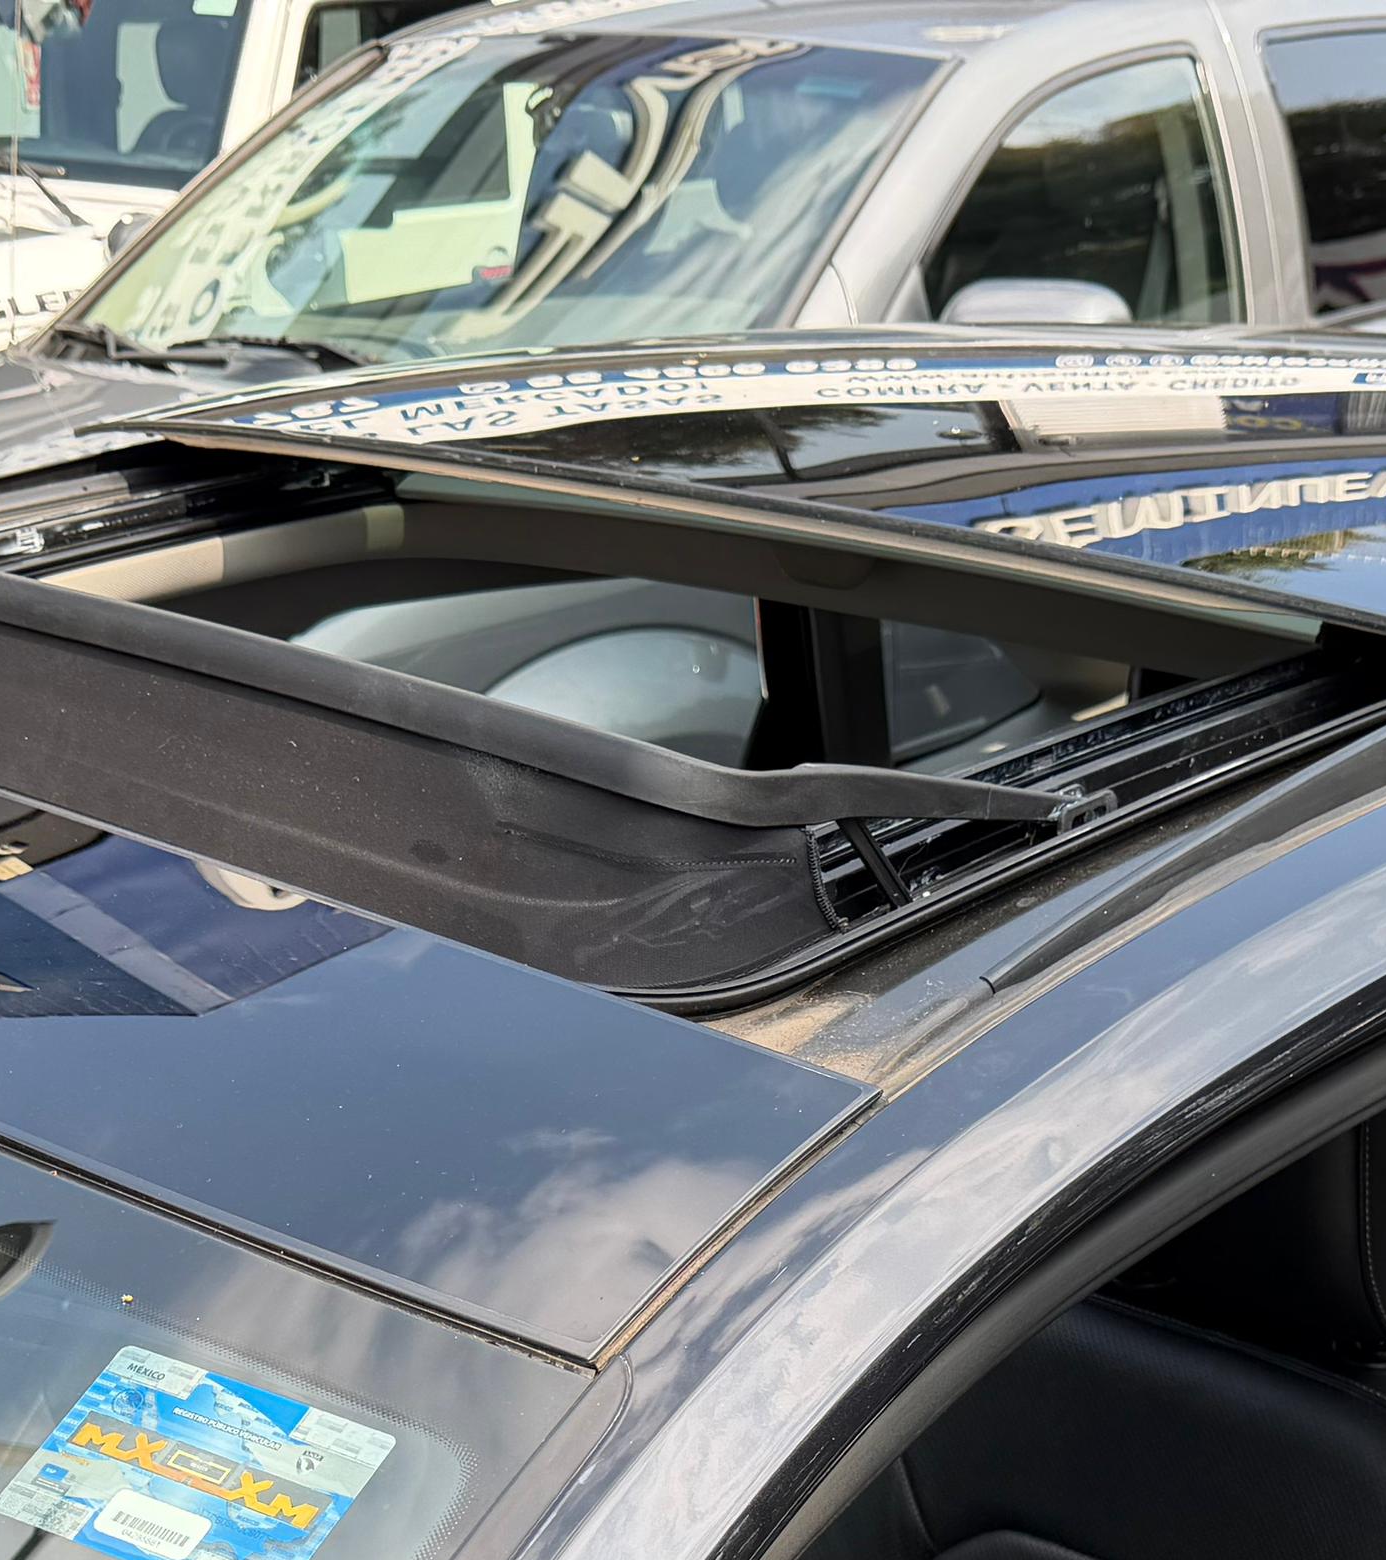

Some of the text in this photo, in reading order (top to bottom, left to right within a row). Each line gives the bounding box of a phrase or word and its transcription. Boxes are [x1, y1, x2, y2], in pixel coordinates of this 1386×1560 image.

[127, 1361, 166, 1381] MÉXICO
[173, 1406, 209, 1425] REGISTRO
[239, 1426, 283, 1451] VEHICULAR
